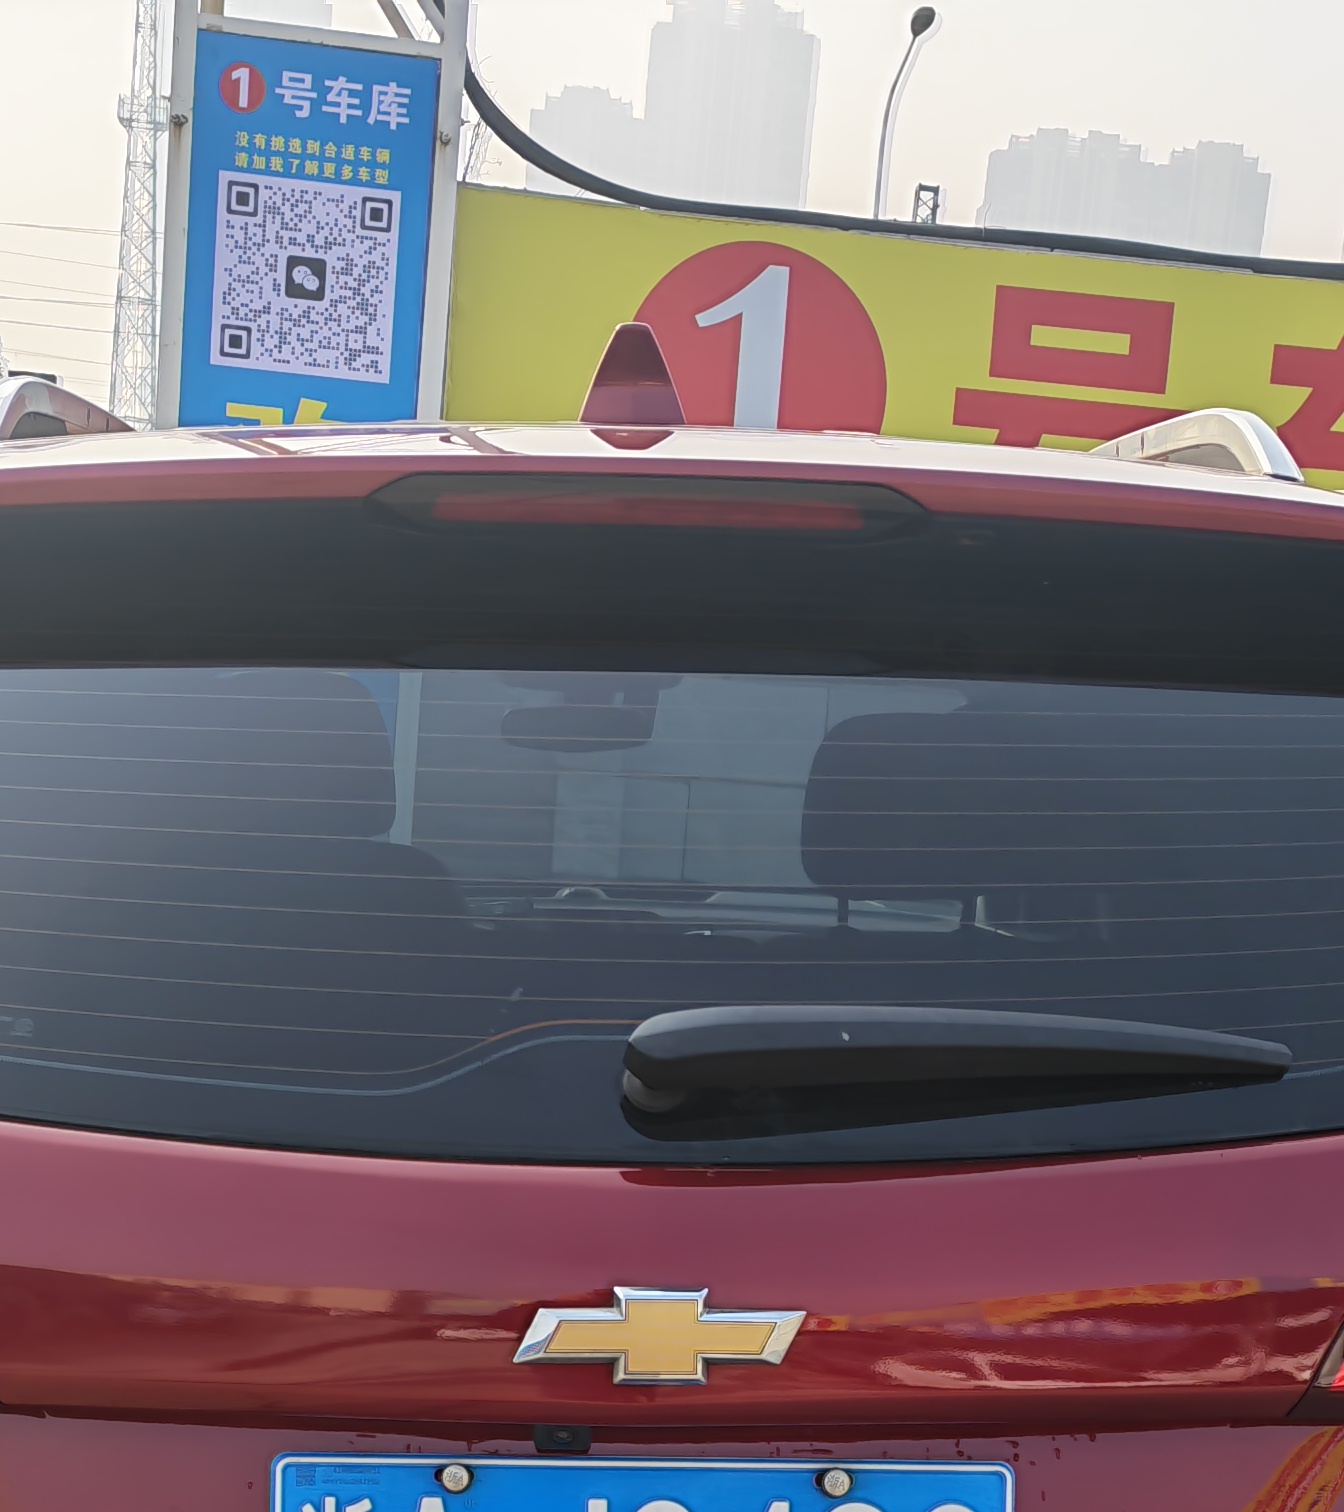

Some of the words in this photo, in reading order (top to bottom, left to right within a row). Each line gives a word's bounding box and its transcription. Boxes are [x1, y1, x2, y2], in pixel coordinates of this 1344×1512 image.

[234, 130, 391, 165] 没有挑选到合适车辆
[234, 151, 390, 185] 请加我了解更多车型
